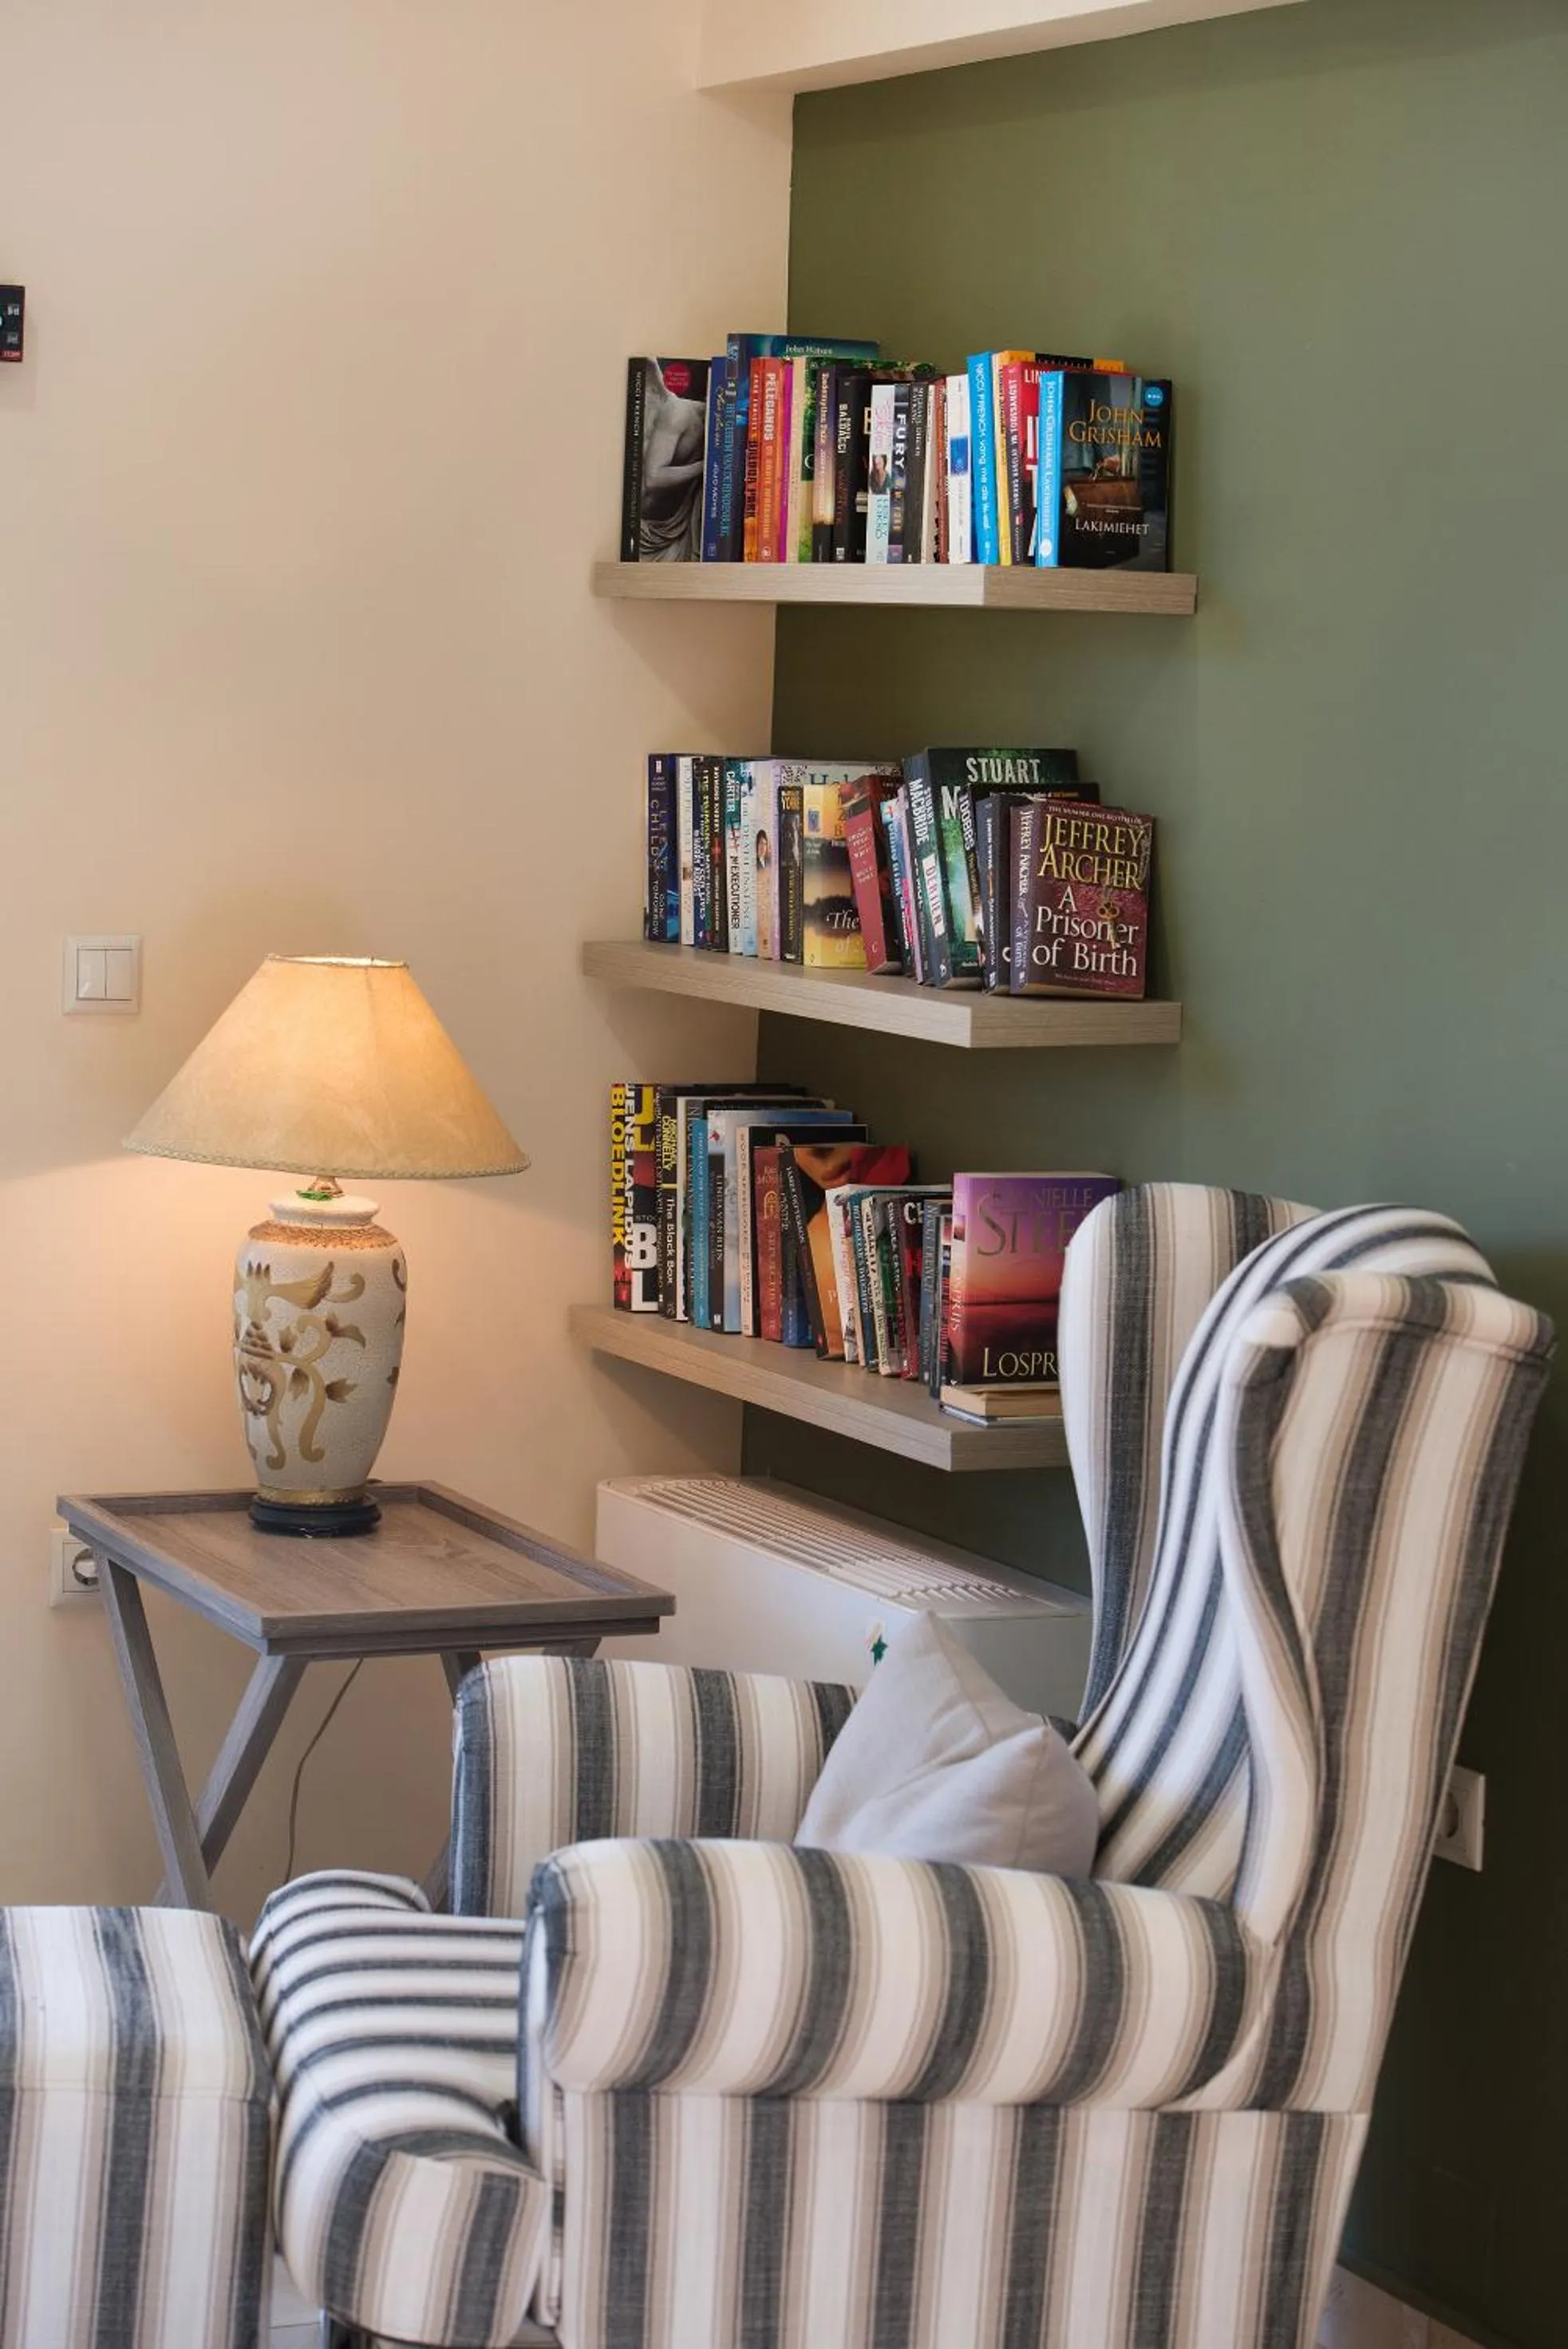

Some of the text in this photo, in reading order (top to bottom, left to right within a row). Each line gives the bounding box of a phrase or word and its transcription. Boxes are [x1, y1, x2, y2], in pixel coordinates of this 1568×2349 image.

[976, 363, 985, 392] NICCI
[1046, 381, 1056, 413] JOHN
[764, 373, 777, 440] PELECANOS
[977, 393, 986, 437] FRENCH
[1089, 400, 1146, 425] JOHN
[837, 404, 847, 454] BALDACCI
[894, 413, 907, 471] FURY
[1045, 415, 1055, 469] GRISHAM
[1068, 420, 1163, 448] GRISHAM
[1075, 518, 1150, 535] LAKIMIEHET
[725, 771, 736, 813] CARTER
[966, 757, 1041, 784] STUART
[908, 779, 930, 847] MACBRIDE
[922, 786, 935, 825] STUART
[1063, 808, 1090, 818] NUMBER
[1104, 814, 1143, 825] BESTSELLER
[650, 799, 660, 857] CHILD
[1041, 813, 1146, 859] JEFFREY
[1018, 810, 1034, 896] JEFFREY ARCHER
[1037, 844, 1142, 890] ARCHER
[730, 867, 741, 930] EXECUTIONER
[827, 909, 859, 931] The
[1059, 886, 1077, 912] A
[1037, 906, 1139, 945] Prisoner
[1033, 938, 1065, 966] of
[1074, 939, 1138, 977] Birth
[612, 1087, 626, 1246] BLOEDLINK
[625, 1084, 636, 1269] JENS LAPIDUS
[715, 1174, 724, 1210] LINDA
[666, 1198, 675, 1285] The Black Box
[715, 1211, 724, 1234] VAN
[887, 1202, 899, 1251] CHELSEA
[859, 1267, 868, 1314] DAUGHTER
[924, 1247, 935, 1292] FRENCH
[982, 1347, 1058, 1379] LOSPR
